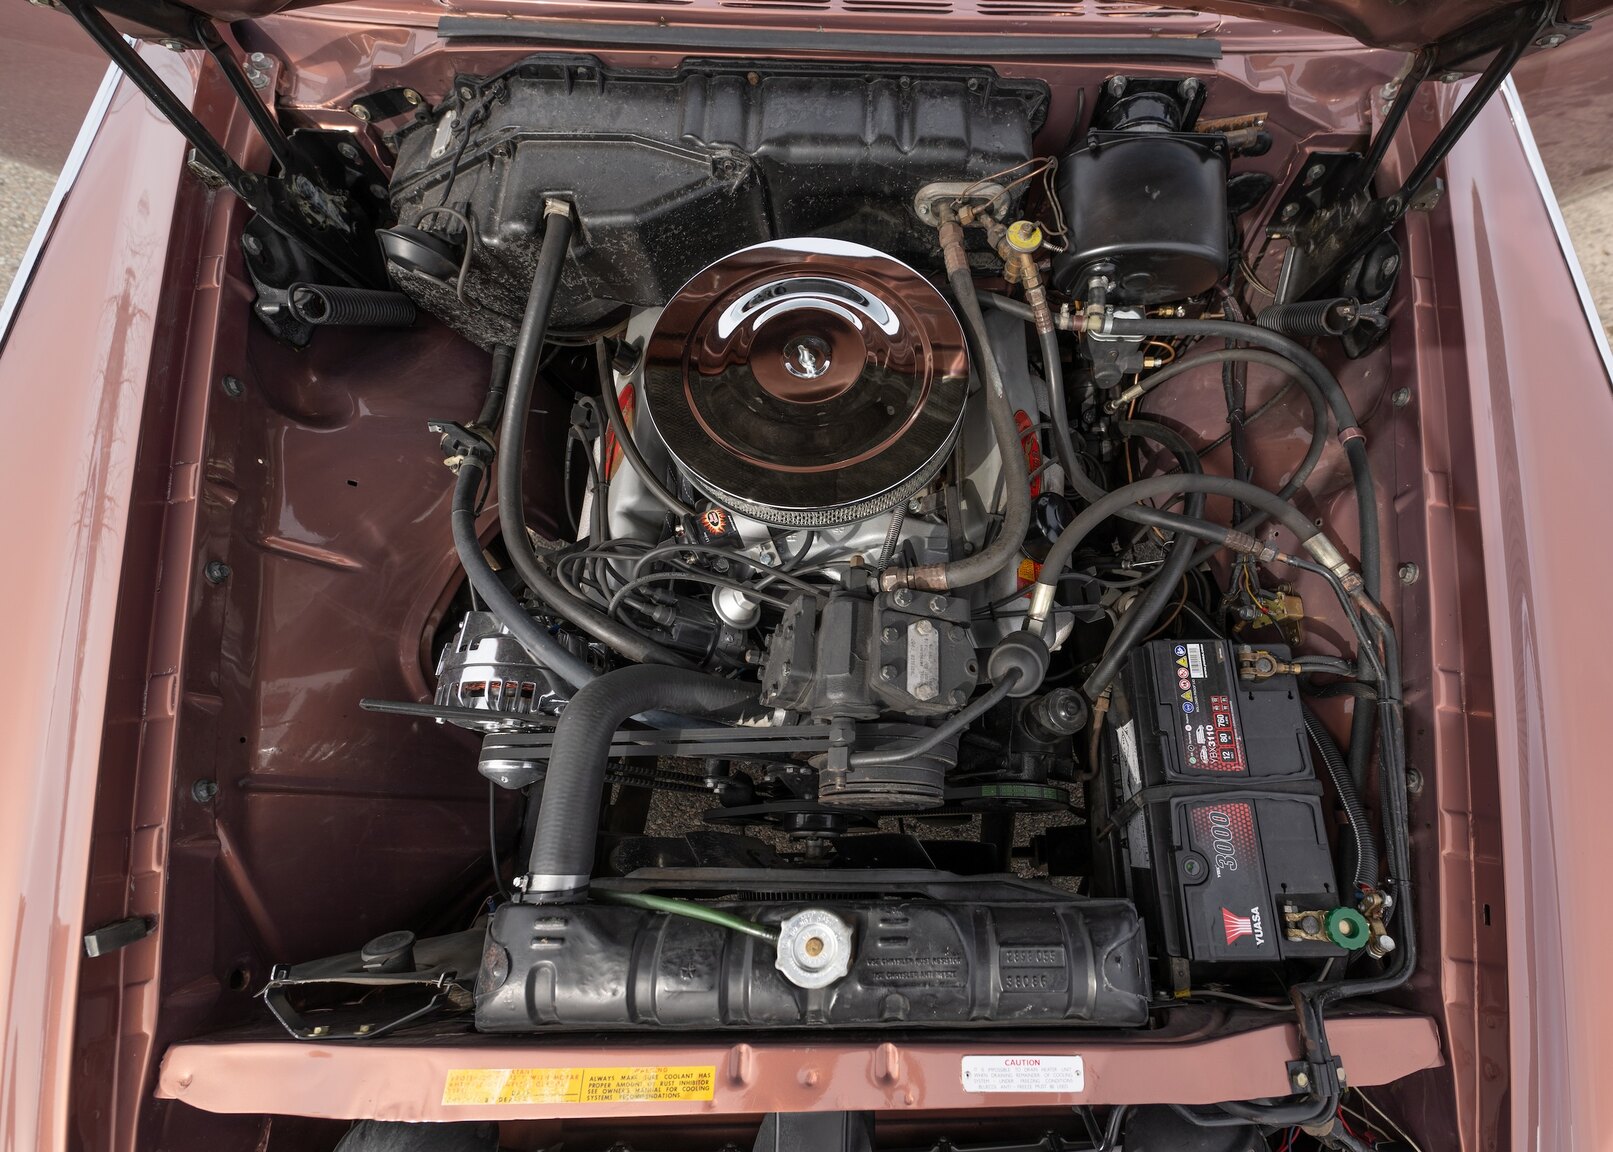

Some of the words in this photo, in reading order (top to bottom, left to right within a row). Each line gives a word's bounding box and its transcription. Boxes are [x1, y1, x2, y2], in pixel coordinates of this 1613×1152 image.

[1216, 714, 1226, 727] 760
[1205, 724, 1219, 764] YBX3110
[1219, 733, 1228, 743] 80
[1222, 751, 1231, 759] 12
[1208, 810, 1238, 871] 3000
[1250, 906, 1265, 946] YUASA
